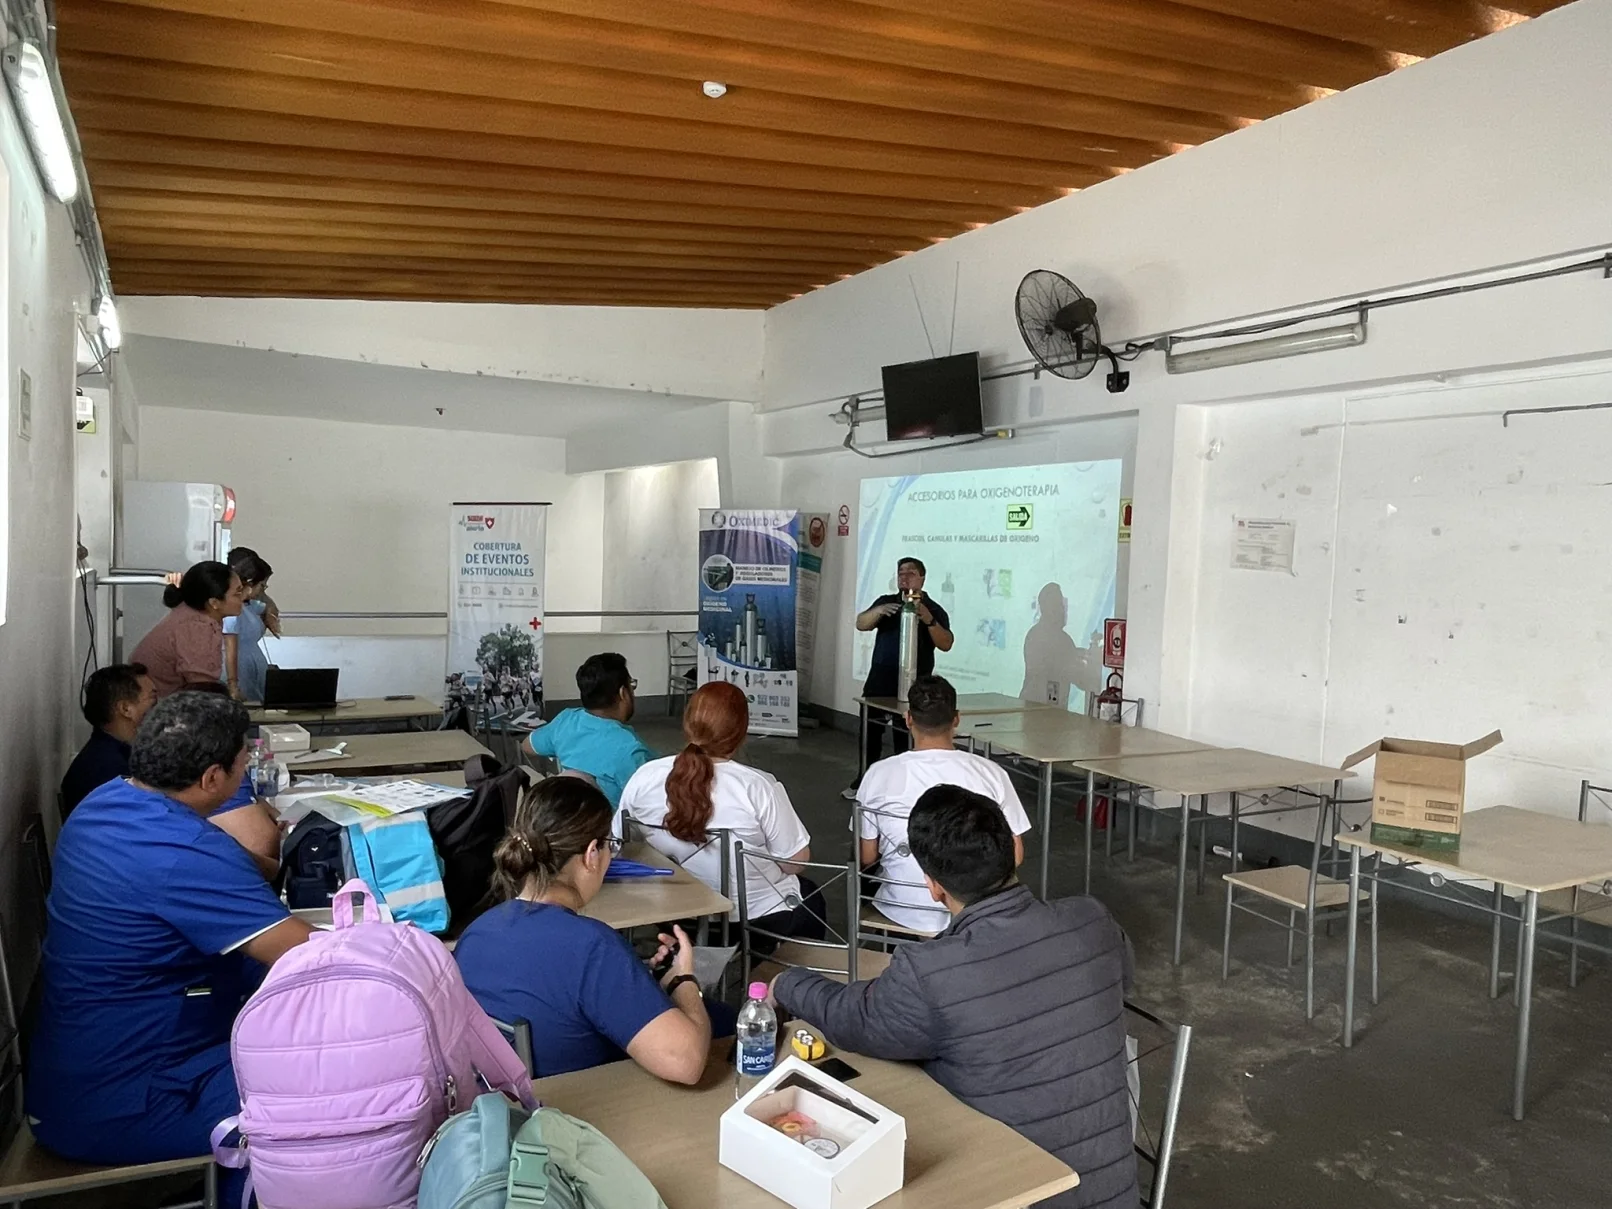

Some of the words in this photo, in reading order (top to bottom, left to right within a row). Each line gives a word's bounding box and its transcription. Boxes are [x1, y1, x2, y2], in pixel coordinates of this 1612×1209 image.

[907, 489, 956, 502] ACCESORIOS
[957, 489, 978, 500] PARA
[980, 484, 1060, 499] OXIGENOTERAPIA
[473, 542, 522, 551] COBERTURA
[465, 553, 480, 564] DE
[482, 553, 530, 566] EVENTOS
[461, 567, 534, 578] INSTITUCIONALES
[743, 1054, 756, 1064] SAN
